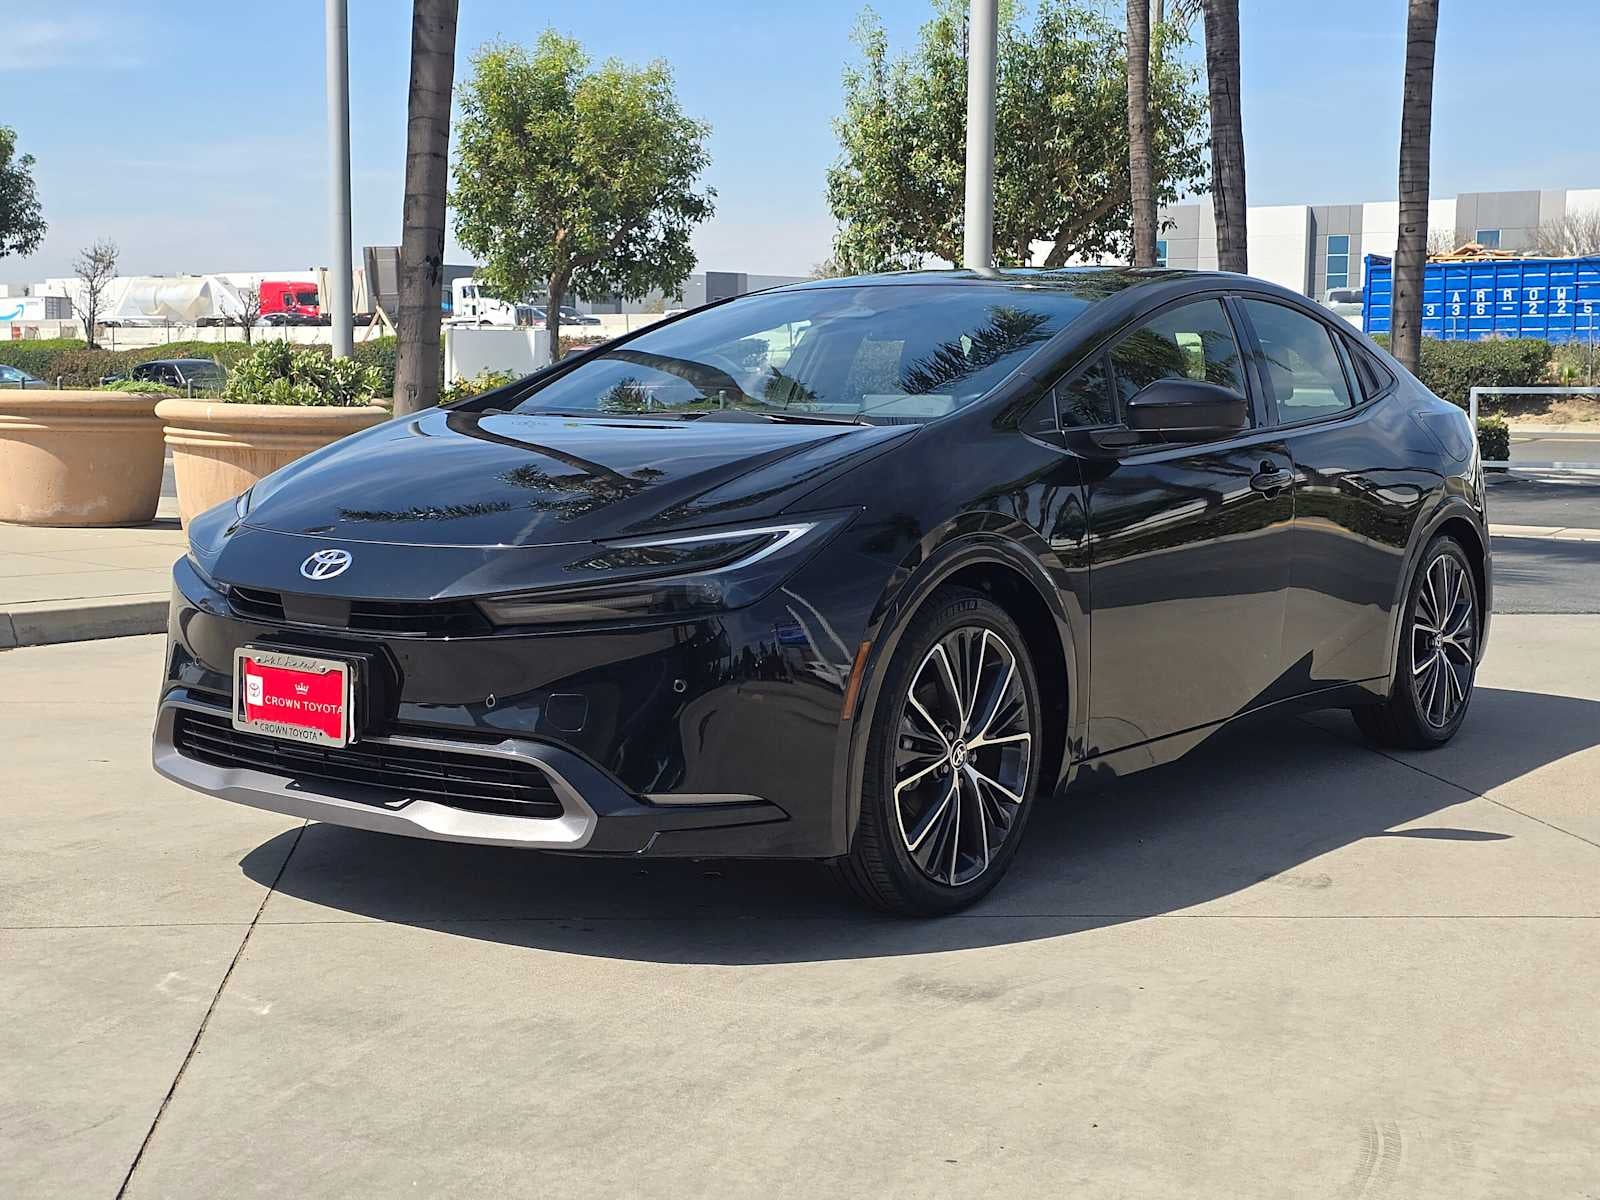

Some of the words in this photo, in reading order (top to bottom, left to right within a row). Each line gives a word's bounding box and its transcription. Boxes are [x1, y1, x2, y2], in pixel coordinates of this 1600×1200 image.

[1452, 288, 1566, 302] ARROW
[264, 695, 301, 710] CROWN
[303, 701, 343, 715] TOYOTA
[260, 722, 288, 735] CROWN
[288, 727, 318, 741] TOYOTA
